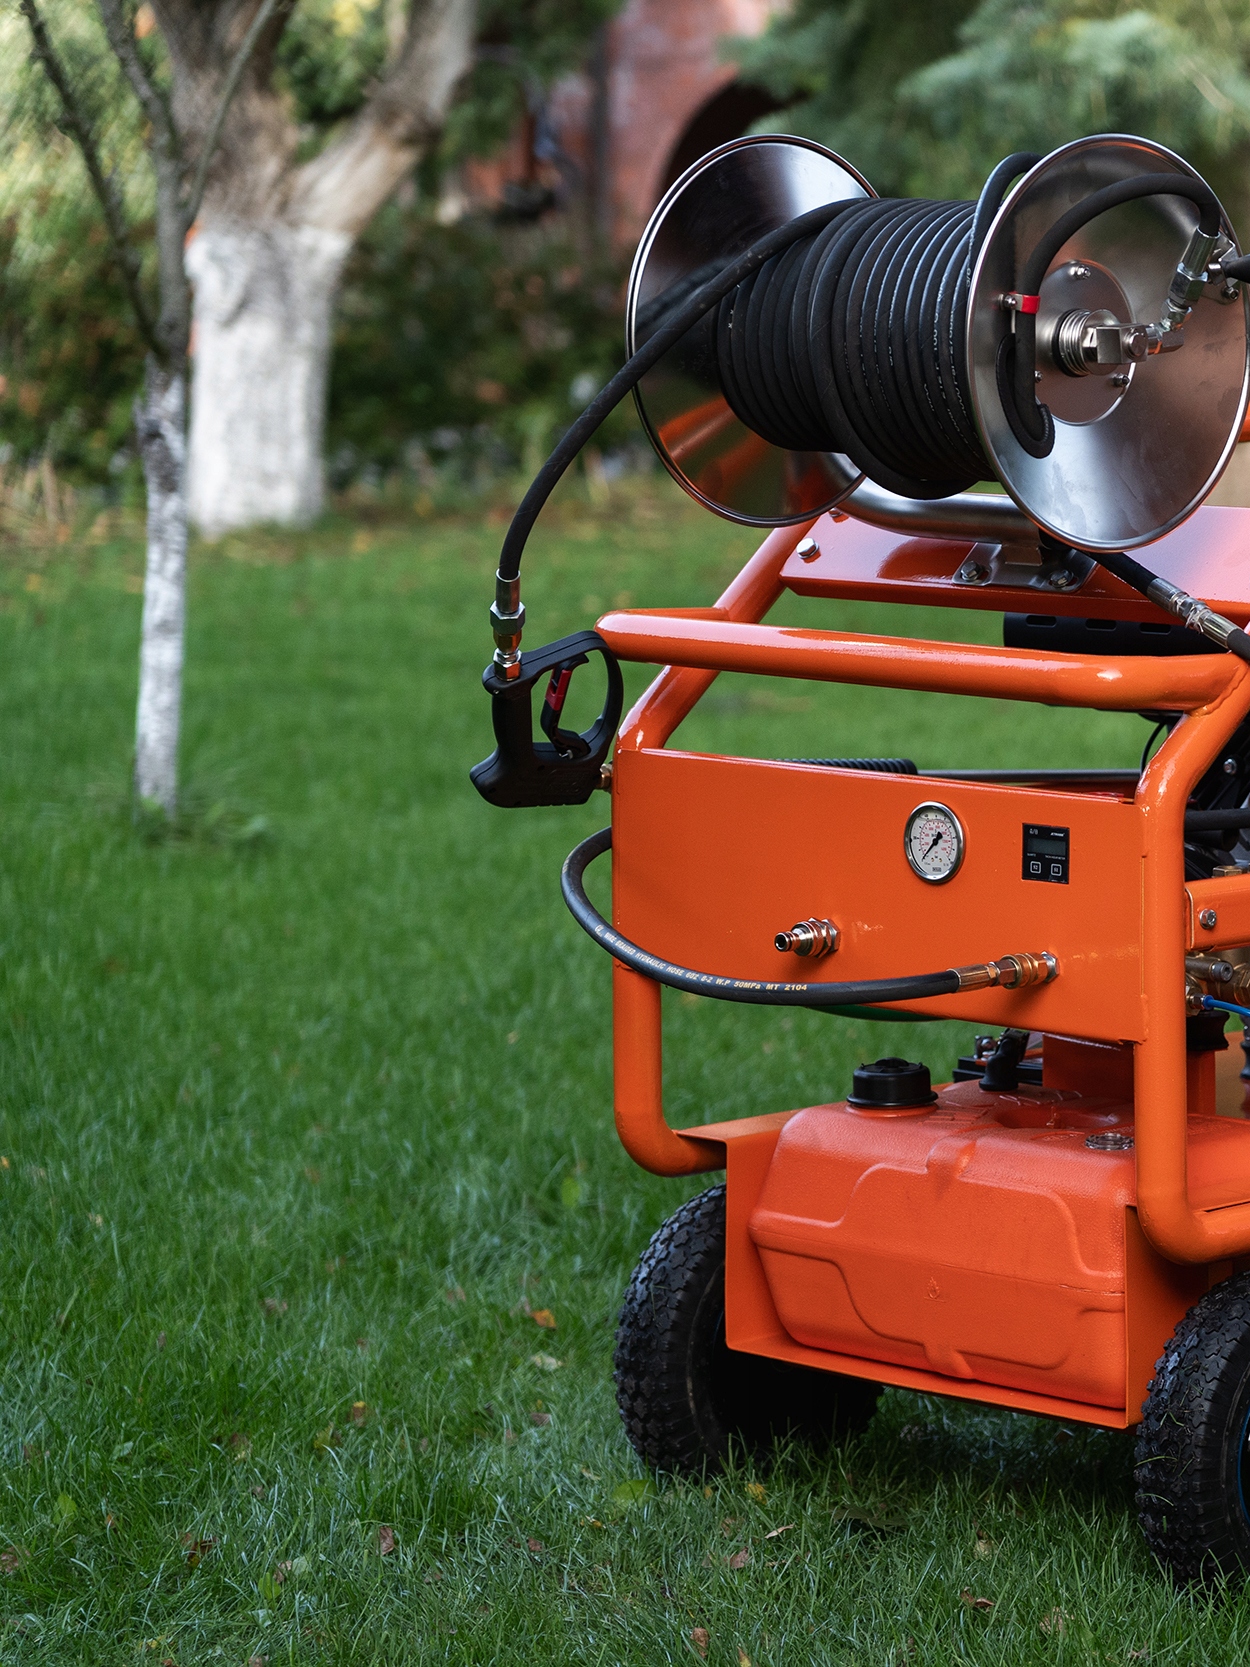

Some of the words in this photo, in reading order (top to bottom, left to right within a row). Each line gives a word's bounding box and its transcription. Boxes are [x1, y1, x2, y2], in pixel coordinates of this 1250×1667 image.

[635, 951, 666, 970] HYDRAULIC
[666, 965, 685, 977] HOSE
[733, 981, 761, 989] 50MPa
[765, 983, 780, 991] MT
